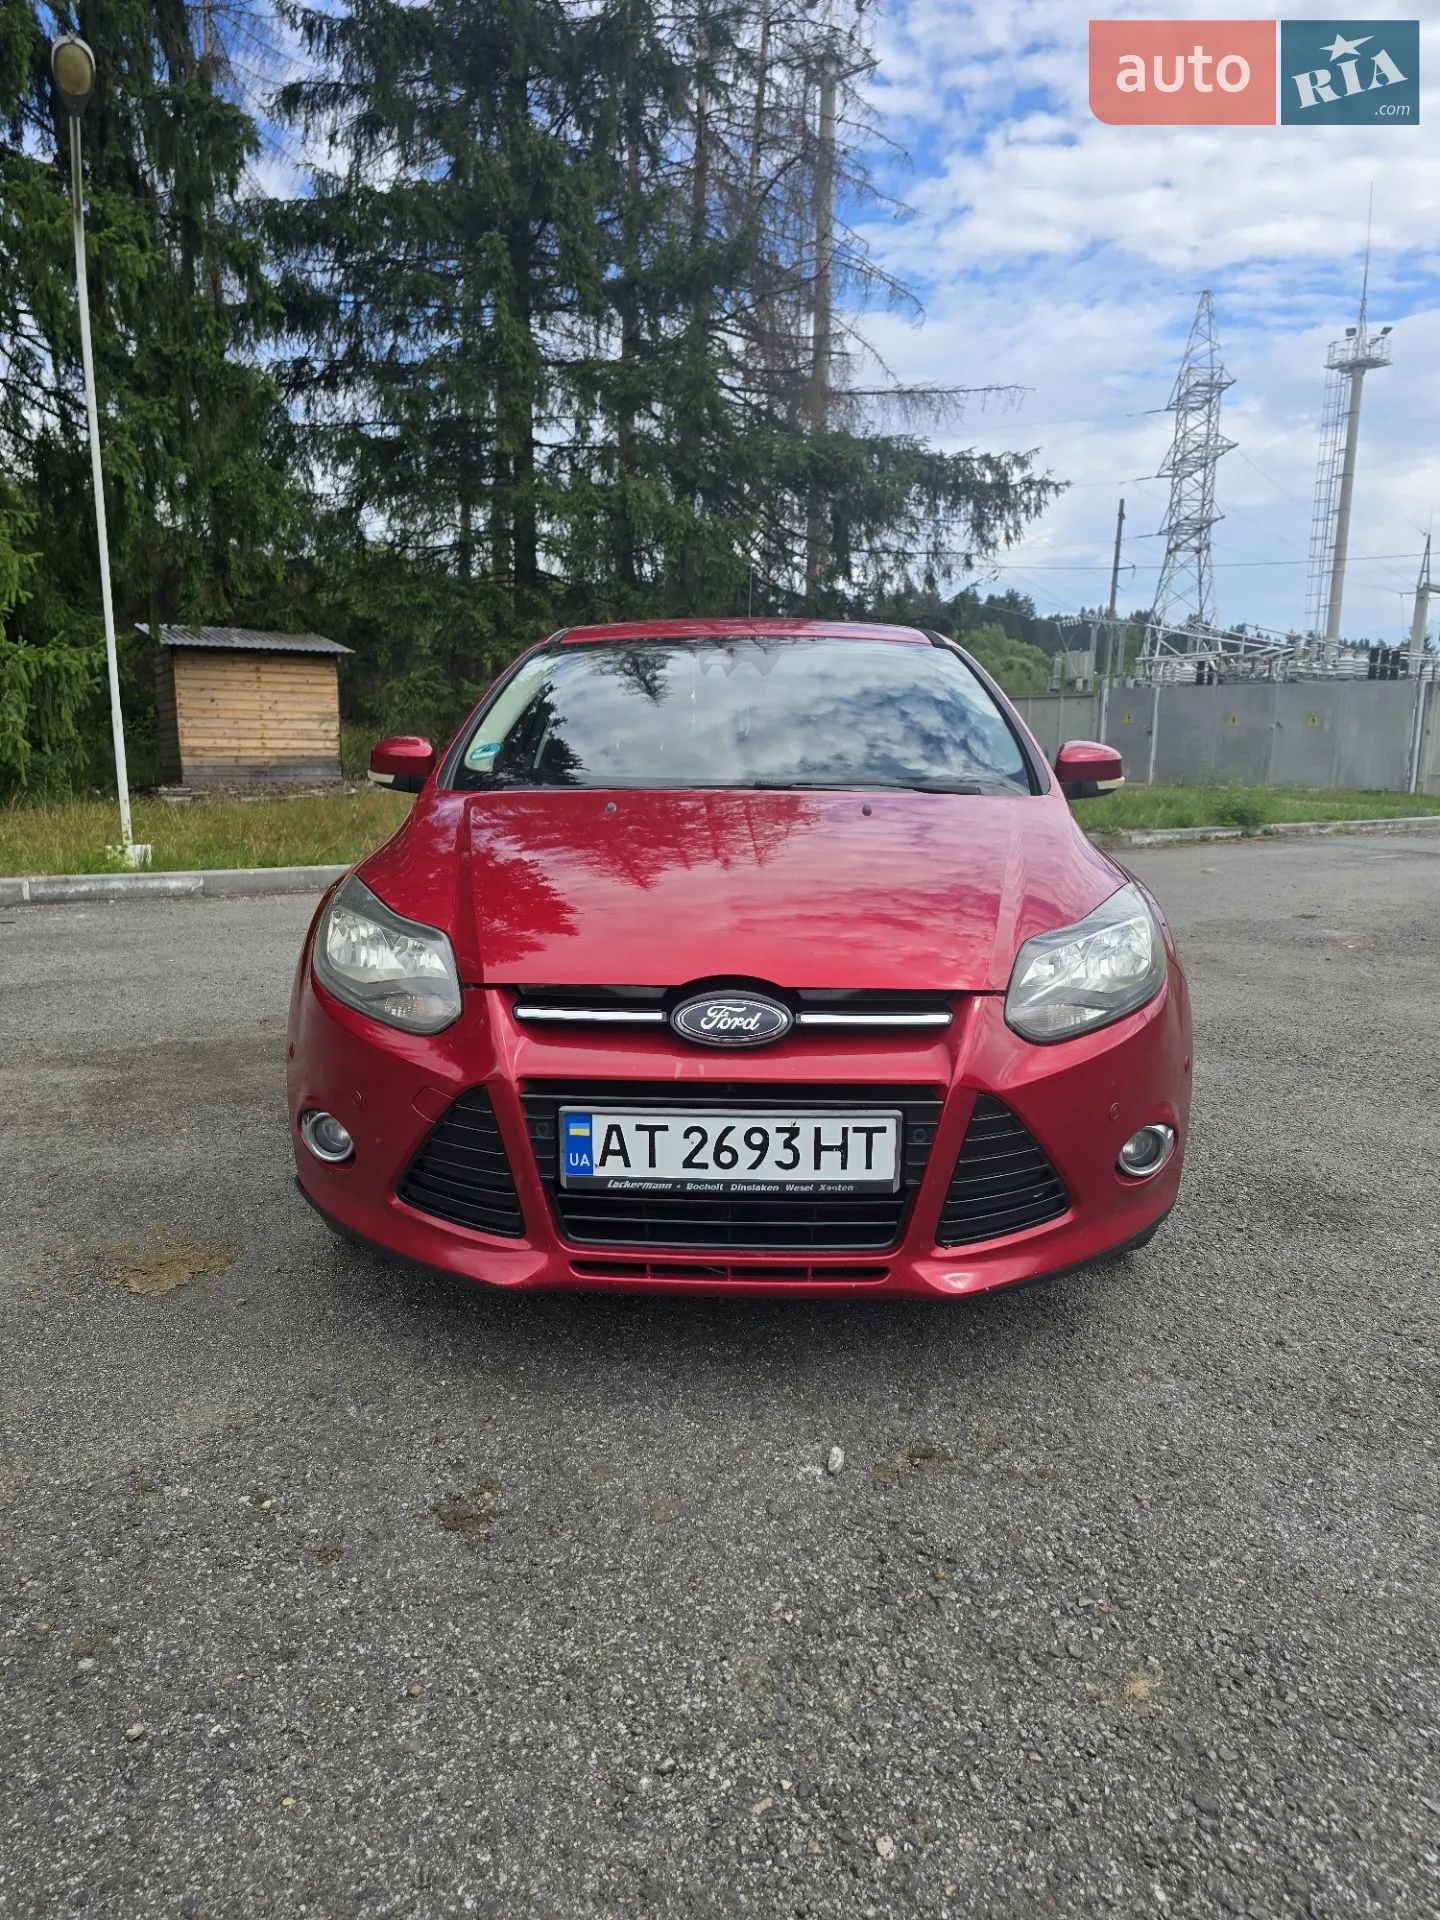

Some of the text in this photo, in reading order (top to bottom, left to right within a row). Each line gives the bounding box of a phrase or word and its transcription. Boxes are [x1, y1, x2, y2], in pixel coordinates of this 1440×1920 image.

[700, 1005, 762, 1031] Ford
[599, 1123, 888, 1171] AT 2693 HT
[569, 1153, 590, 1167] UA
[686, 1182, 724, 1191] Bocholt
[730, 1183, 780, 1192] Dinslaken
[785, 1183, 814, 1192] Wesel
